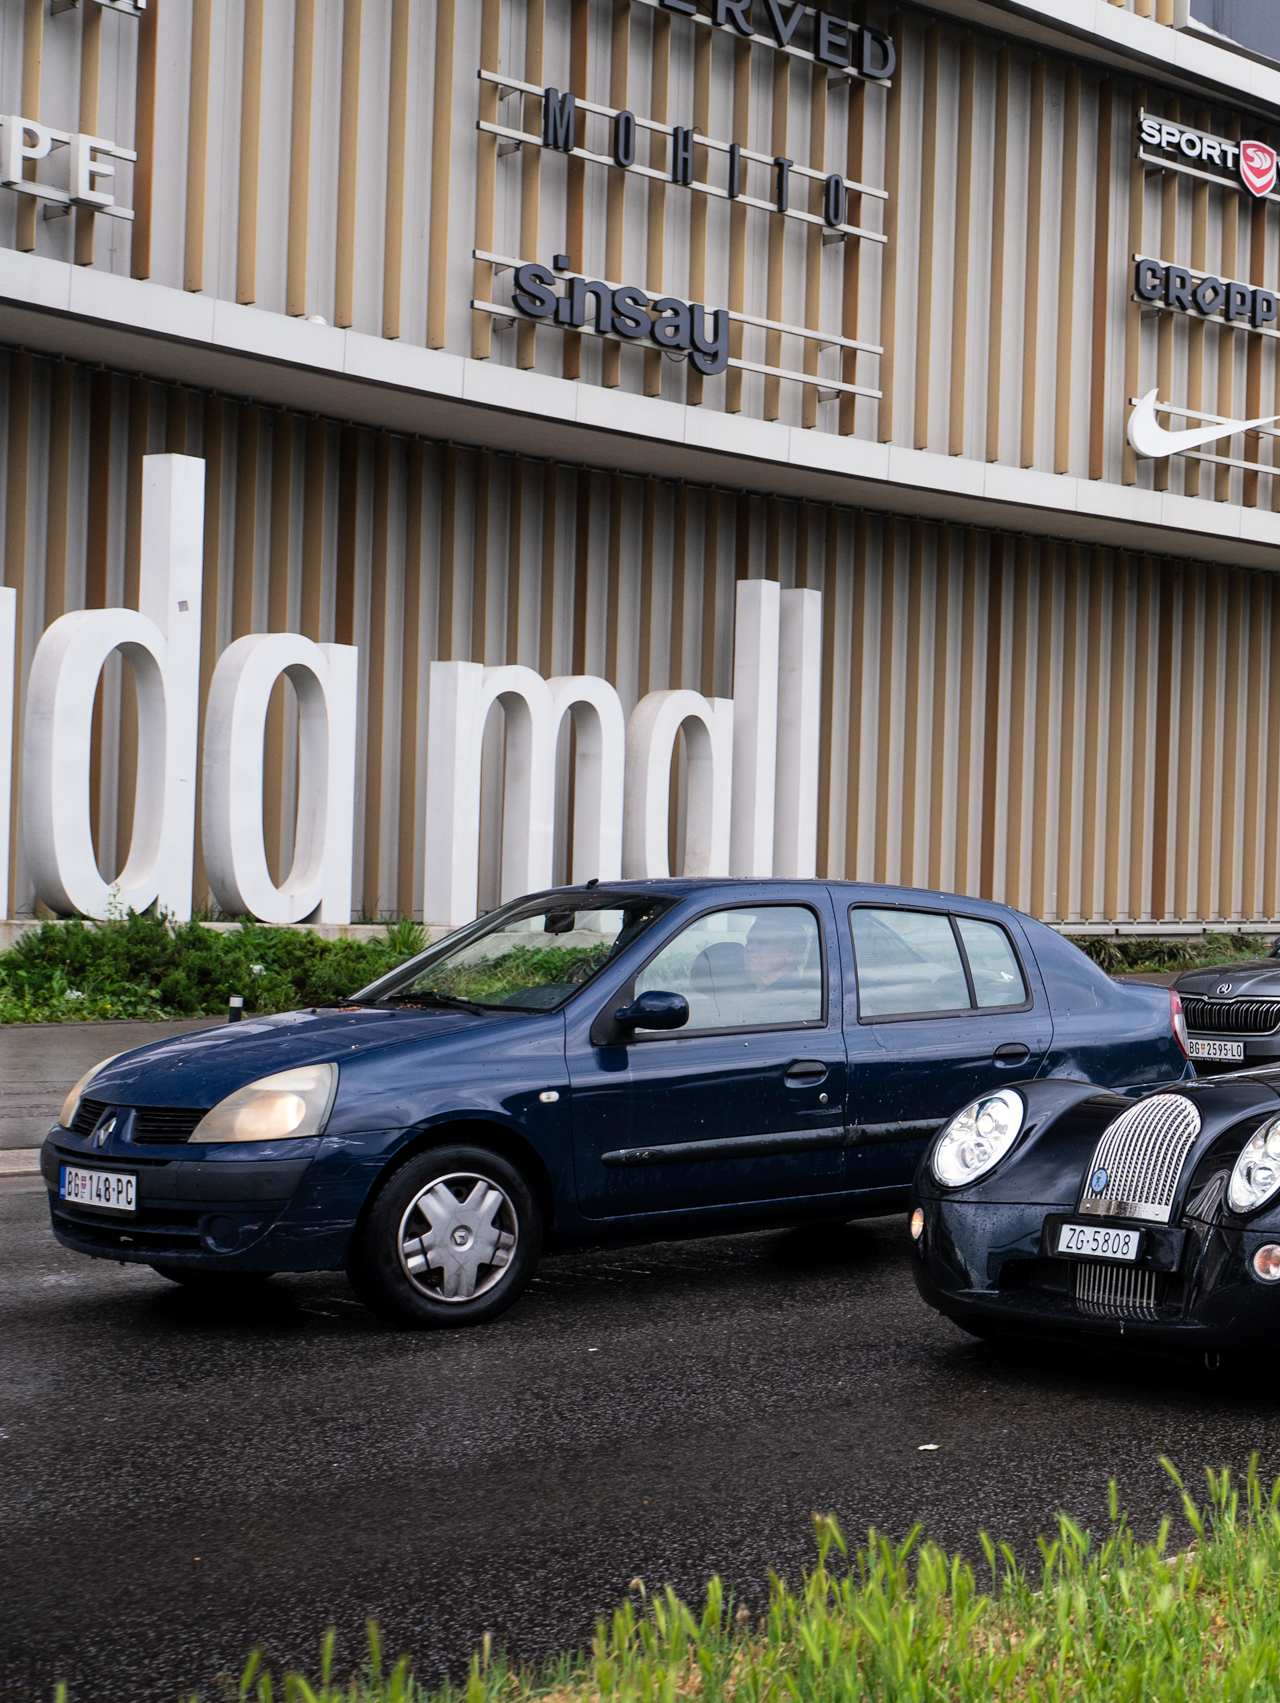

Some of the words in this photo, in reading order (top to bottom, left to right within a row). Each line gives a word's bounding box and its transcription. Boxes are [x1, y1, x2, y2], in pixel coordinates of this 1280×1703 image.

[659, 0, 896, 78] RVED
[0, 115, 115, 208] PE
[543, 87, 845, 227] MOHITO
[1140, 119, 1239, 169] SPORT
[511, 254, 730, 376] sinsay
[1135, 258, 1278, 328] CROPP
[0, 453, 359, 925] da
[423, 578, 822, 926] mall
[1189, 1041, 1200, 1055] BG
[67, 1170, 80, 1198] BG
